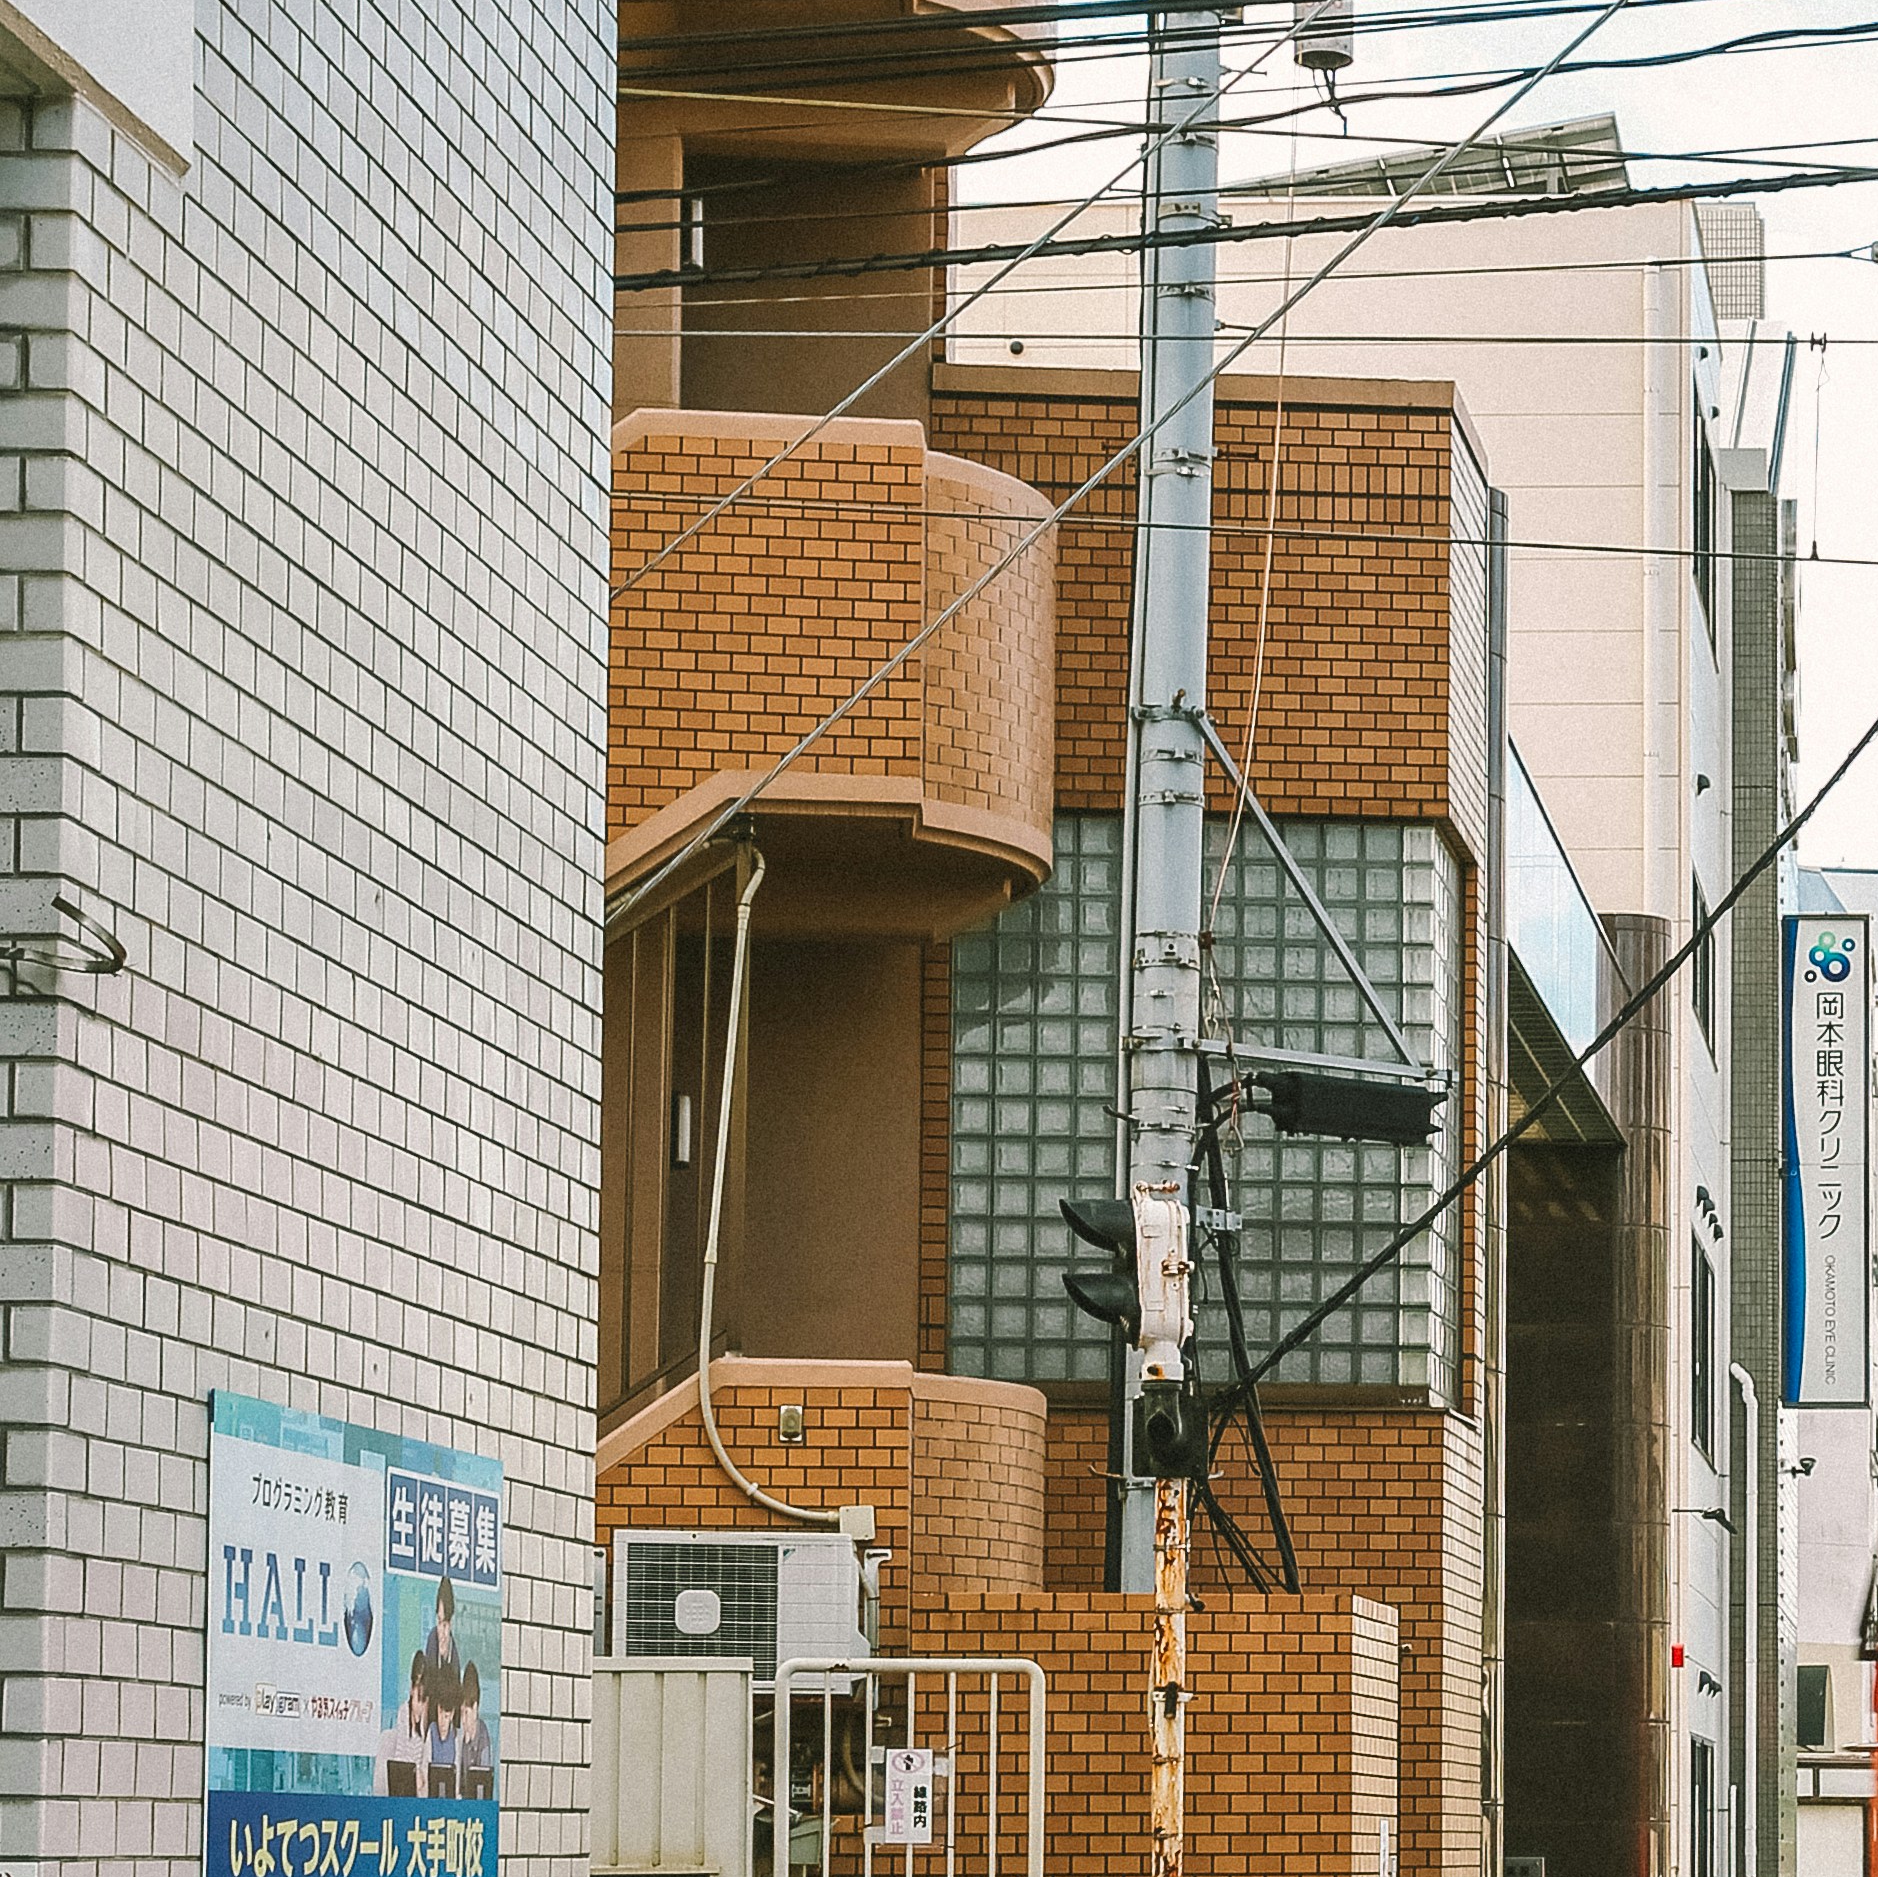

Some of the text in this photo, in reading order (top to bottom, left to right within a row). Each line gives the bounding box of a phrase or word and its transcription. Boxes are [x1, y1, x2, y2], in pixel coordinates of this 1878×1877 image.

[1816, 992, 1845, 1240] 岡本眼科クリニック
[1824, 1254, 1836, 1385] OKAMOTO EYE CLINIC
[252, 1472, 349, 1525] プログラミング教育
[392, 1485, 497, 1575] 生徒募集
[890, 1779, 905, 1836] 立入禁止
